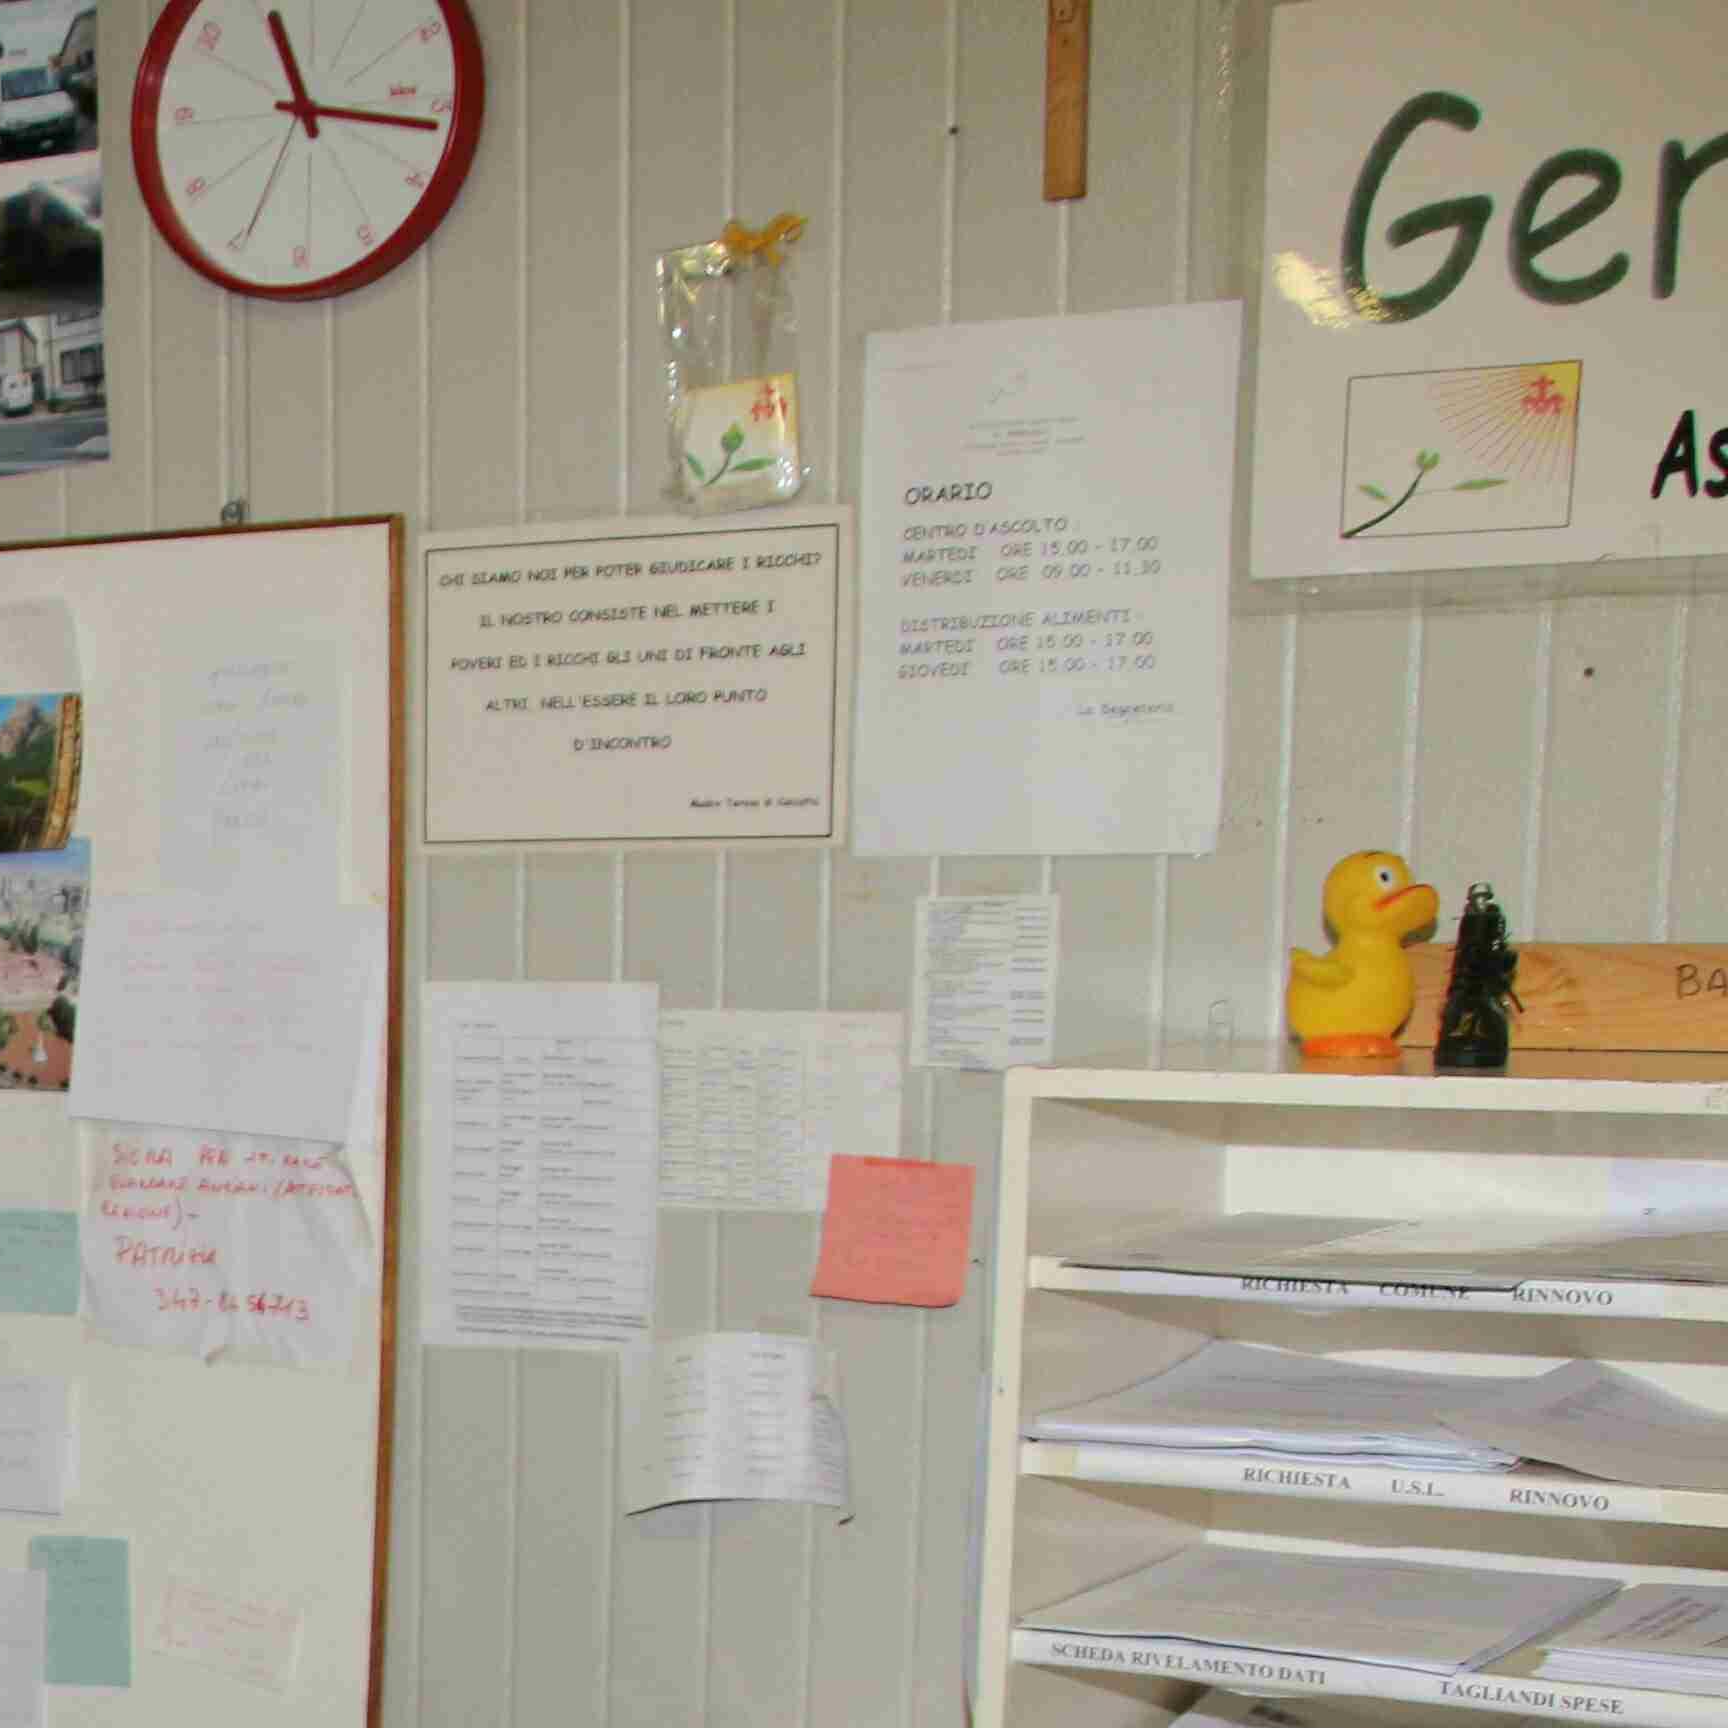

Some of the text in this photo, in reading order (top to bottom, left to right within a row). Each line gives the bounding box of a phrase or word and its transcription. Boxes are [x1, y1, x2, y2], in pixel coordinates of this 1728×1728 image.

[1341, 90, 1728, 324] Ger
[904, 481, 993, 506] ORARIO
[903, 523, 968, 541] CENTRO
[1000, 541, 1032, 558] ORE
[472, 571, 521, 585] SIAMO
[527, 568, 557, 582] NOI
[563, 567, 589, 580] PER
[595, 564, 642, 578] POTER
[649, 556, 734, 576] GIUDICARE
[995, 564, 1028, 581] ORE
[479, 600, 761, 629] IL NOSTRO CONSISTE NEL METTERE
[901, 608, 1131, 633] DISTRIBUZIONE ALIMENTI
[450, 641, 806, 671] POVERI ED RICCHI GLI UNI DI FRONTE AGLI
[996, 635, 1029, 652] ORE
[999, 657, 1033, 675] ORE
[644, 692, 660, 707] IL
[665, 690, 706, 705] LORO
[713, 687, 768, 704] PUNTO
[1512, 1284, 1614, 1306] RINNOVO
[1242, 1466, 1352, 1491] RICHIESTA
[1508, 1486, 1611, 1513] RINNOVO
[1050, 1641, 1626, 1715] SCHEDA RIVELAMENTO DATI TAGLIANDI SPESE
